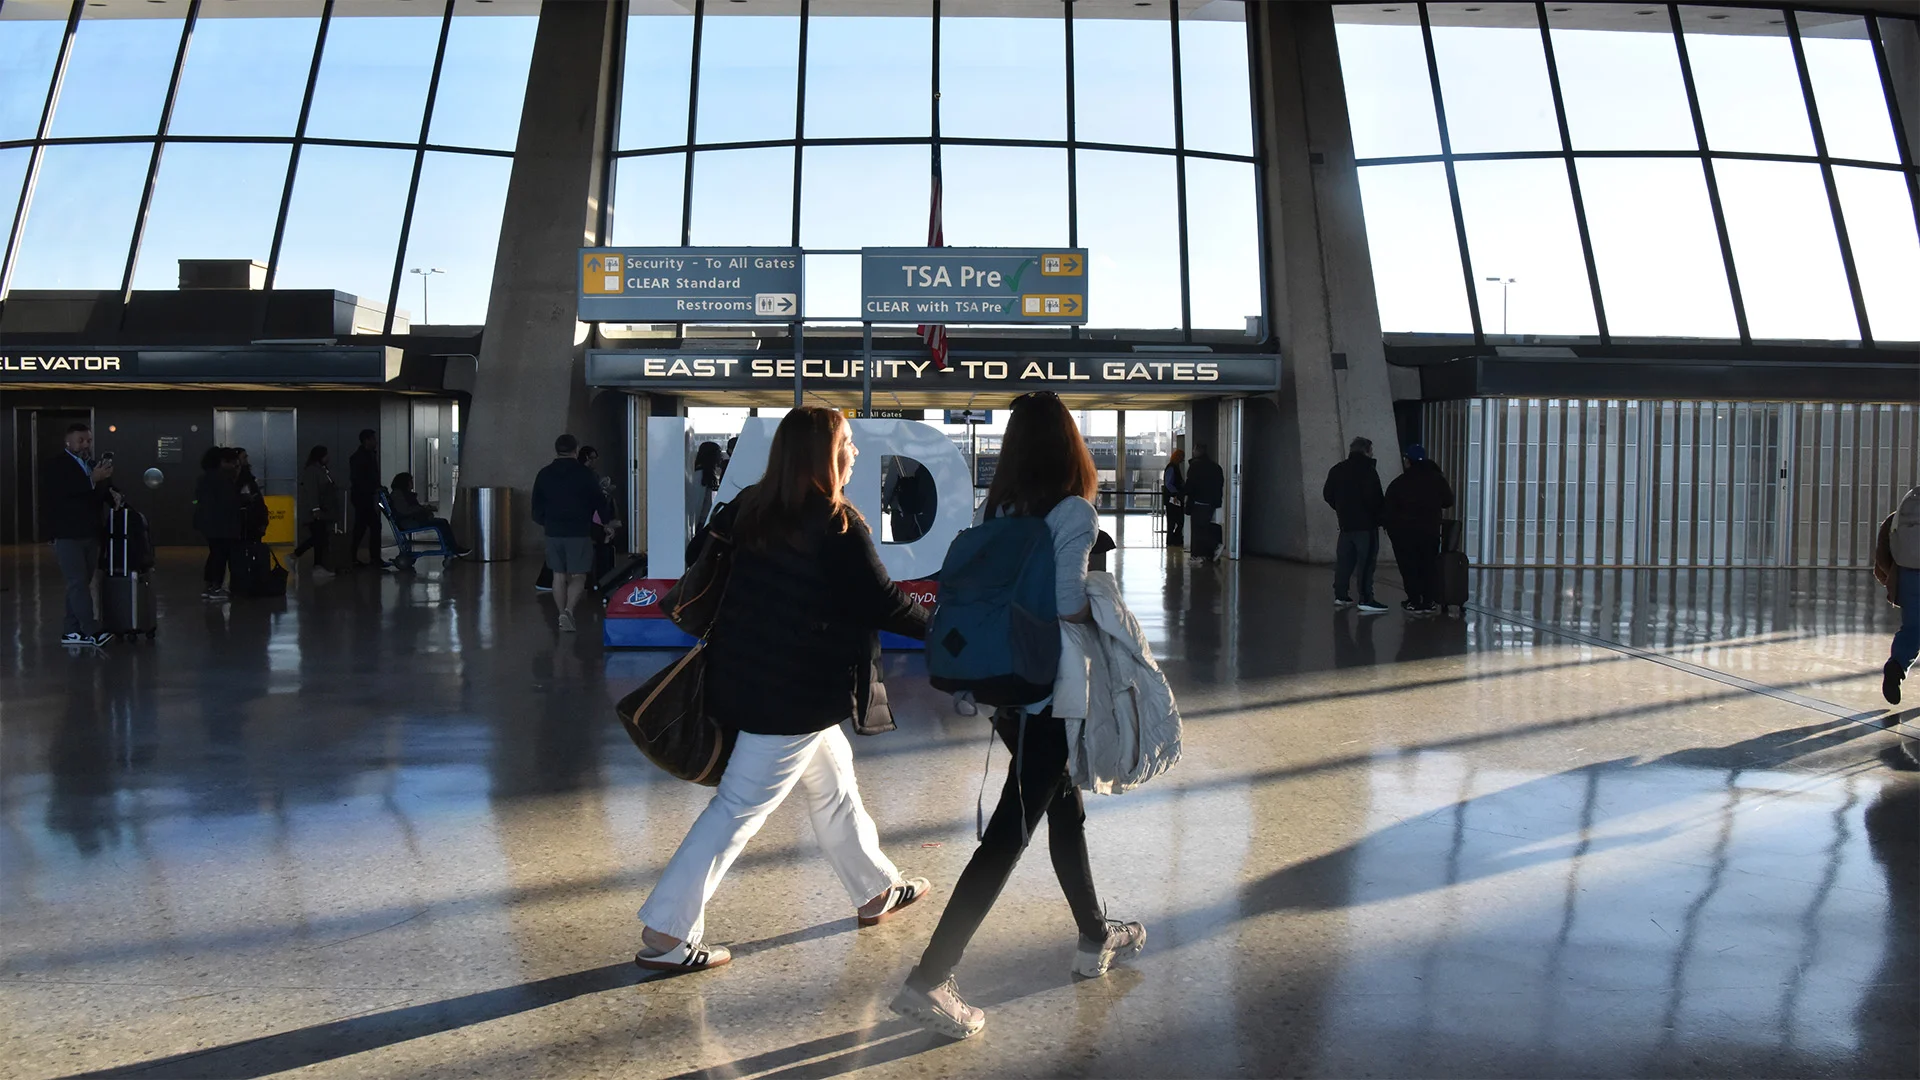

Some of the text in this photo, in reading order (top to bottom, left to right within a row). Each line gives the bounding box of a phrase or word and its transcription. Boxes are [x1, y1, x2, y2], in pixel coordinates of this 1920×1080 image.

[627, 258, 684, 271] Security
[705, 258, 722, 269] To
[729, 258, 748, 269] All
[754, 258, 796, 269] Gates
[627, 277, 740, 289] CLEAR Standard
[902, 266, 1002, 287] TSA Pre
[677, 300, 752, 310] Restrooms
[867, 301, 1002, 312] CLEAR with TSA Pre
[0, 356, 120, 370] LEVATOR
[644, 358, 738, 377] EAST
[752, 359, 931, 378] SECURITY
[960, 361, 1008, 379] TO
[1020, 361, 1090, 380] ALL
[1102, 362, 1218, 381] GATES
